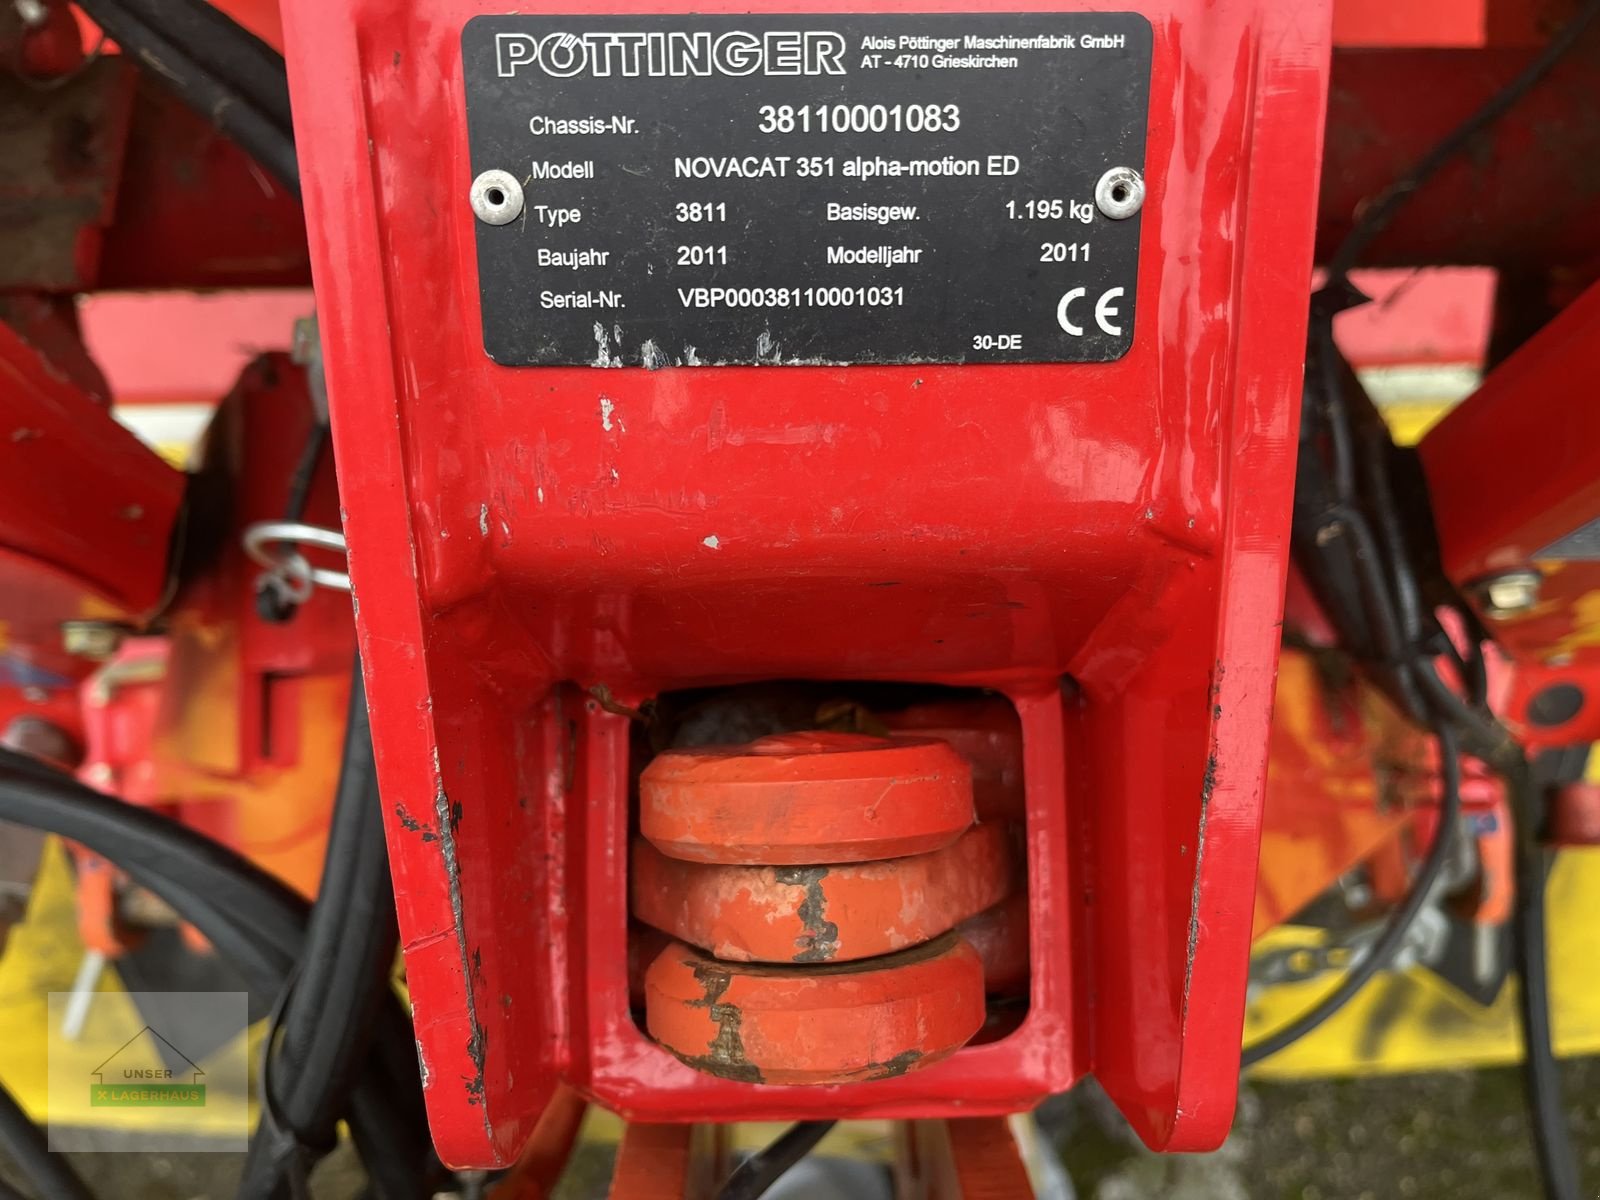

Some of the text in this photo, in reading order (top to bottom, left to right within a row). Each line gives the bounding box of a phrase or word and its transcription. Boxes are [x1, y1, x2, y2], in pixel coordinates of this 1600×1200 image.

[496, 31, 846, 77] PÖTTINGER
[861, 34, 1125, 54] Alois Pöttinger Maschinenfabrik GmbH
[860, 55, 882, 68] AT
[893, 54, 930, 69] 4710
[932, 54, 1018, 68] Grieskirchen
[530, 104, 960, 135] Chassis-Nr. 38110001083
[532, 155, 1019, 181] Modell NOVACAT 351 alpha-motion ED
[534, 202, 725, 227] Type 3811
[827, 199, 1094, 224] Basisgew. 1.195 kg
[538, 246, 726, 270] Baujahr 2011
[827, 243, 1089, 267] Modelljahr 2011
[541, 287, 903, 308] Serial-Nr. VBP00038110001031
[973, 335, 1022, 349] 30-DE
